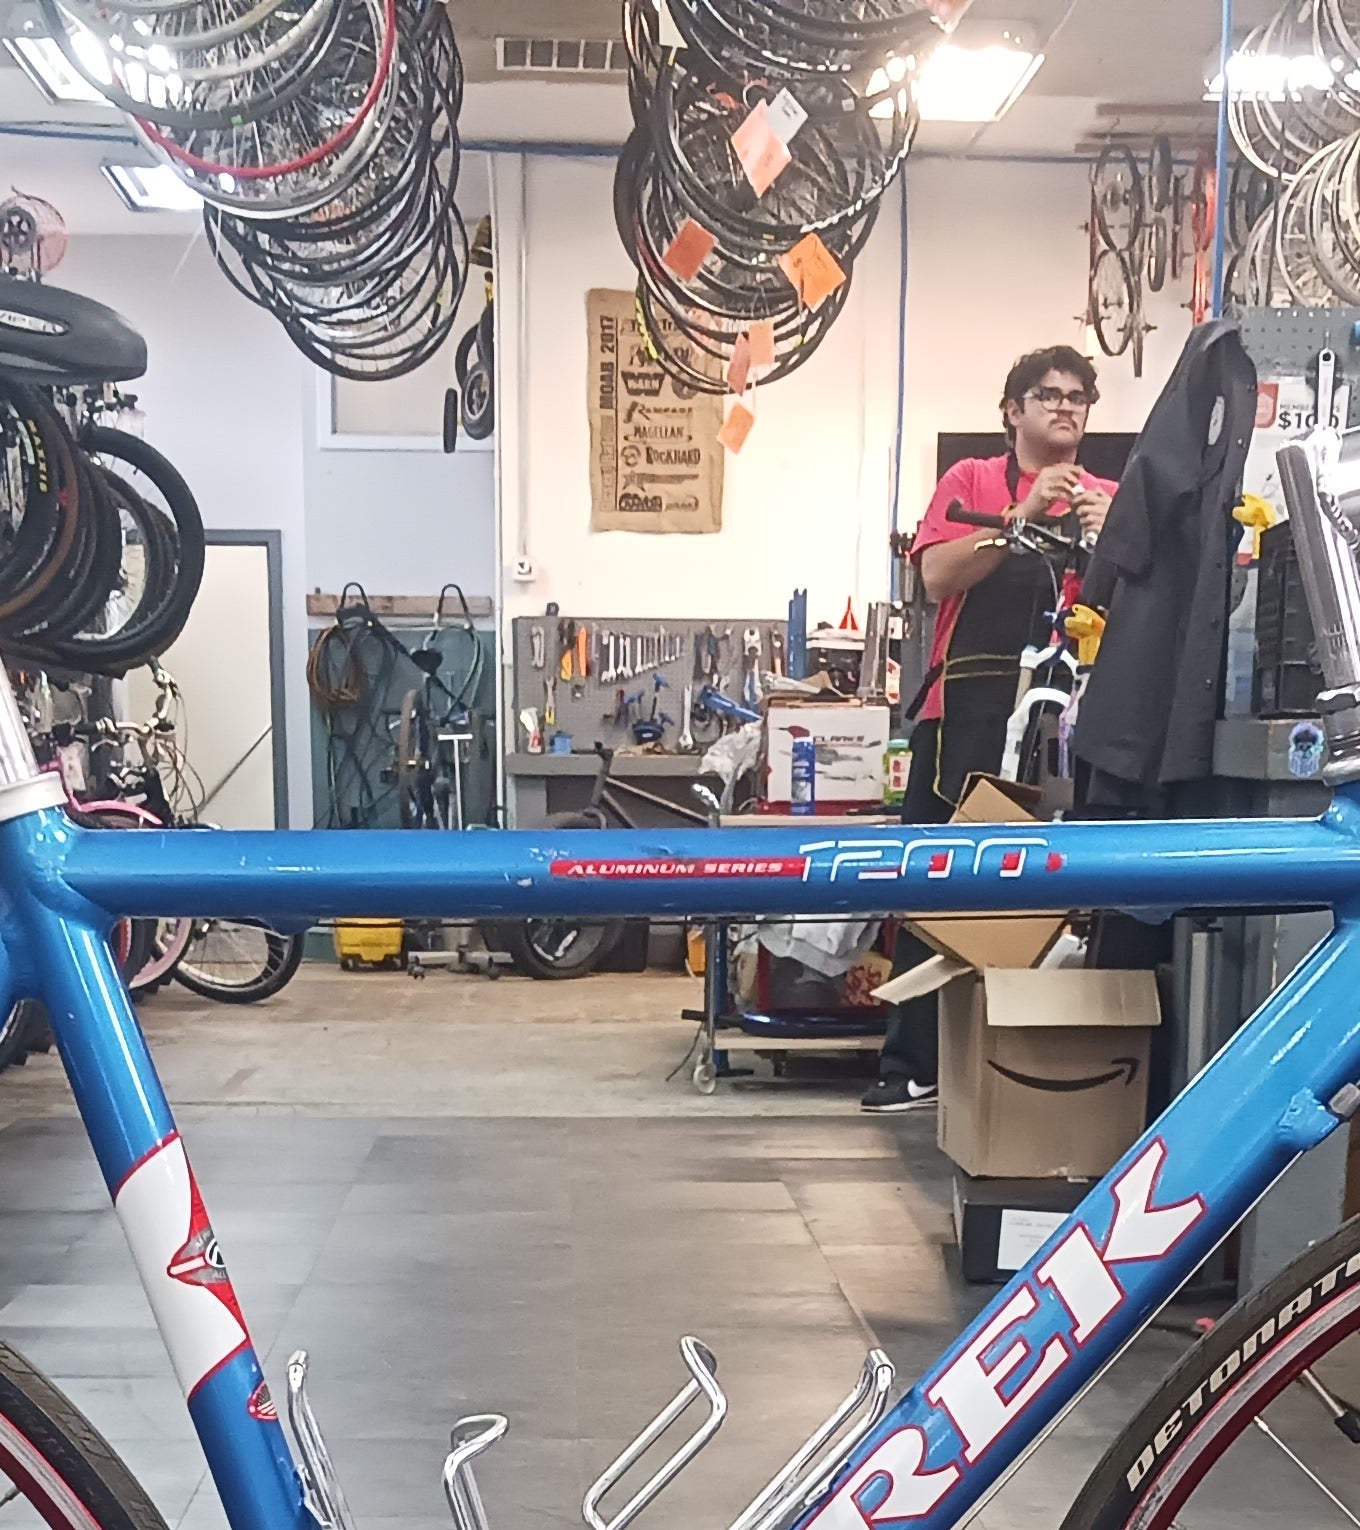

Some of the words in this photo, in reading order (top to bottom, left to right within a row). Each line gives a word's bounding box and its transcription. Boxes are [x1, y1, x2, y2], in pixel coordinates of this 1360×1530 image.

[567, 862, 696, 876] ALUMINUM
[703, 861, 784, 875] SERIES
[799, 837, 1048, 882] 1200
